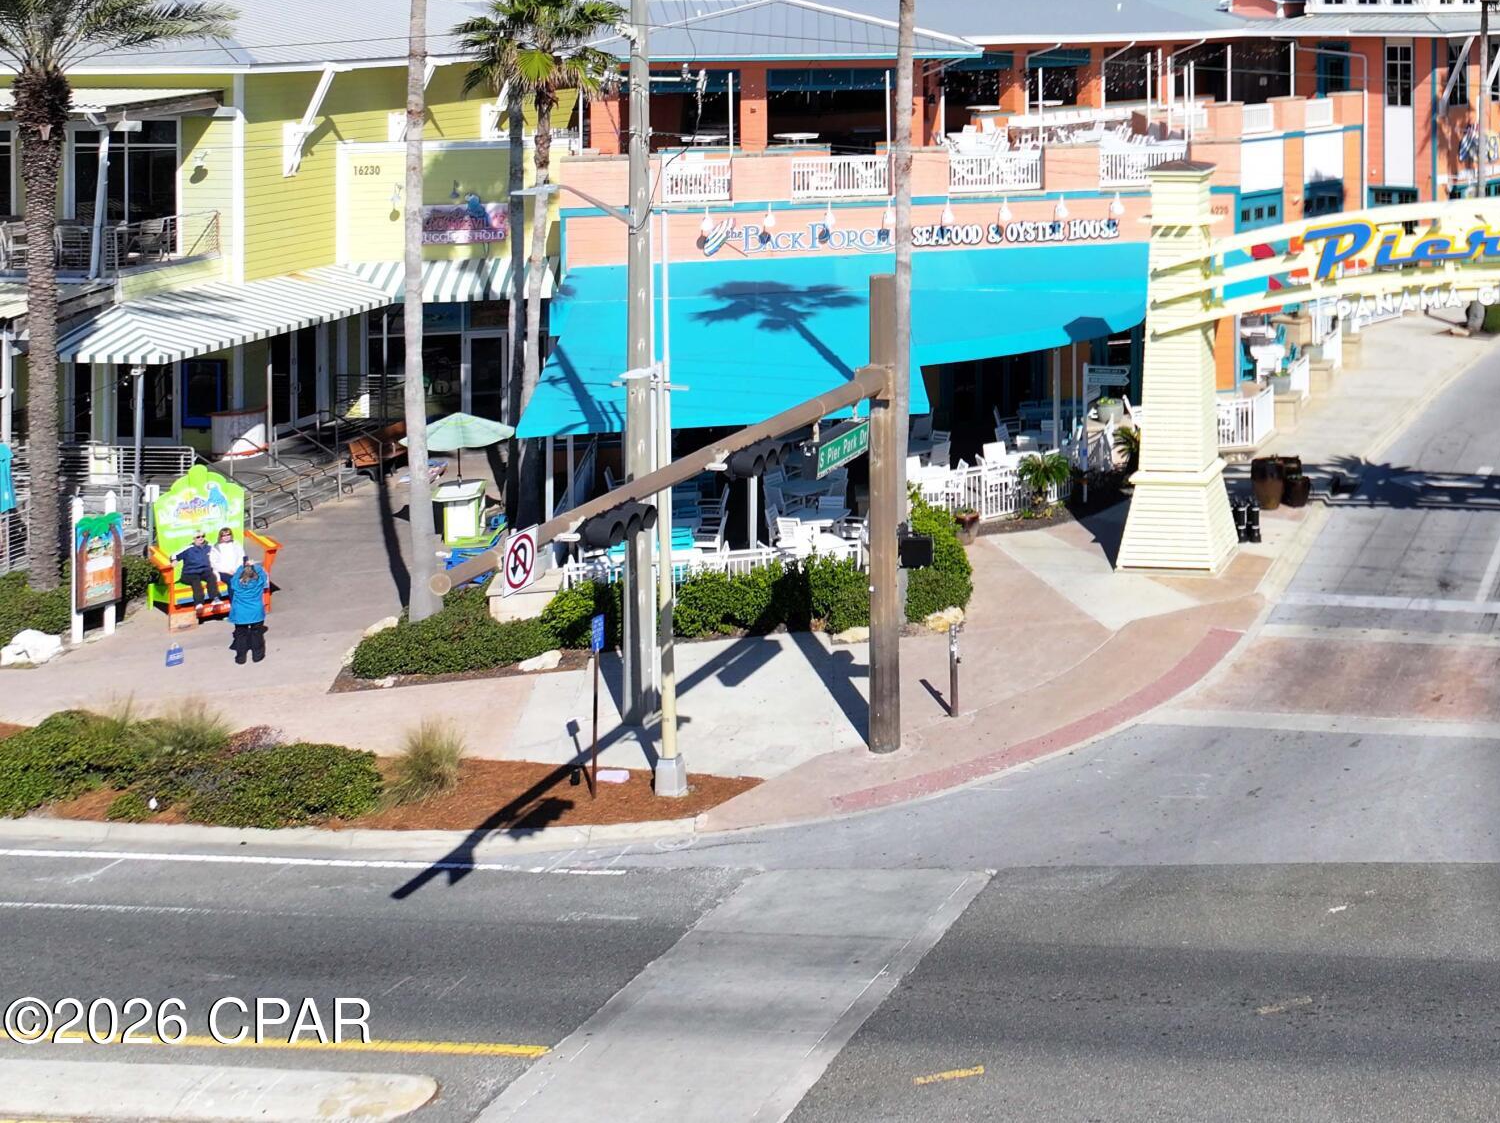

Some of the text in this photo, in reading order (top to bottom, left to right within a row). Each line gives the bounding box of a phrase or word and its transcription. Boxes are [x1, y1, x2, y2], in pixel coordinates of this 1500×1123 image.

[354, 165, 381, 176] 16230
[474, 230, 505, 241] HOLD
[743, 225, 807, 252] BACK
[808, 222, 893, 251] PORCH
[911, 218, 1120, 246] SEAFOOD & OYSTER HOUSE
[1336, 288, 1463, 321] PANAMA
[819, 451, 825, 469] S
[827, 446, 841, 465] Pier
[843, 434, 857, 455] Park
[859, 429, 868, 446] Dr
